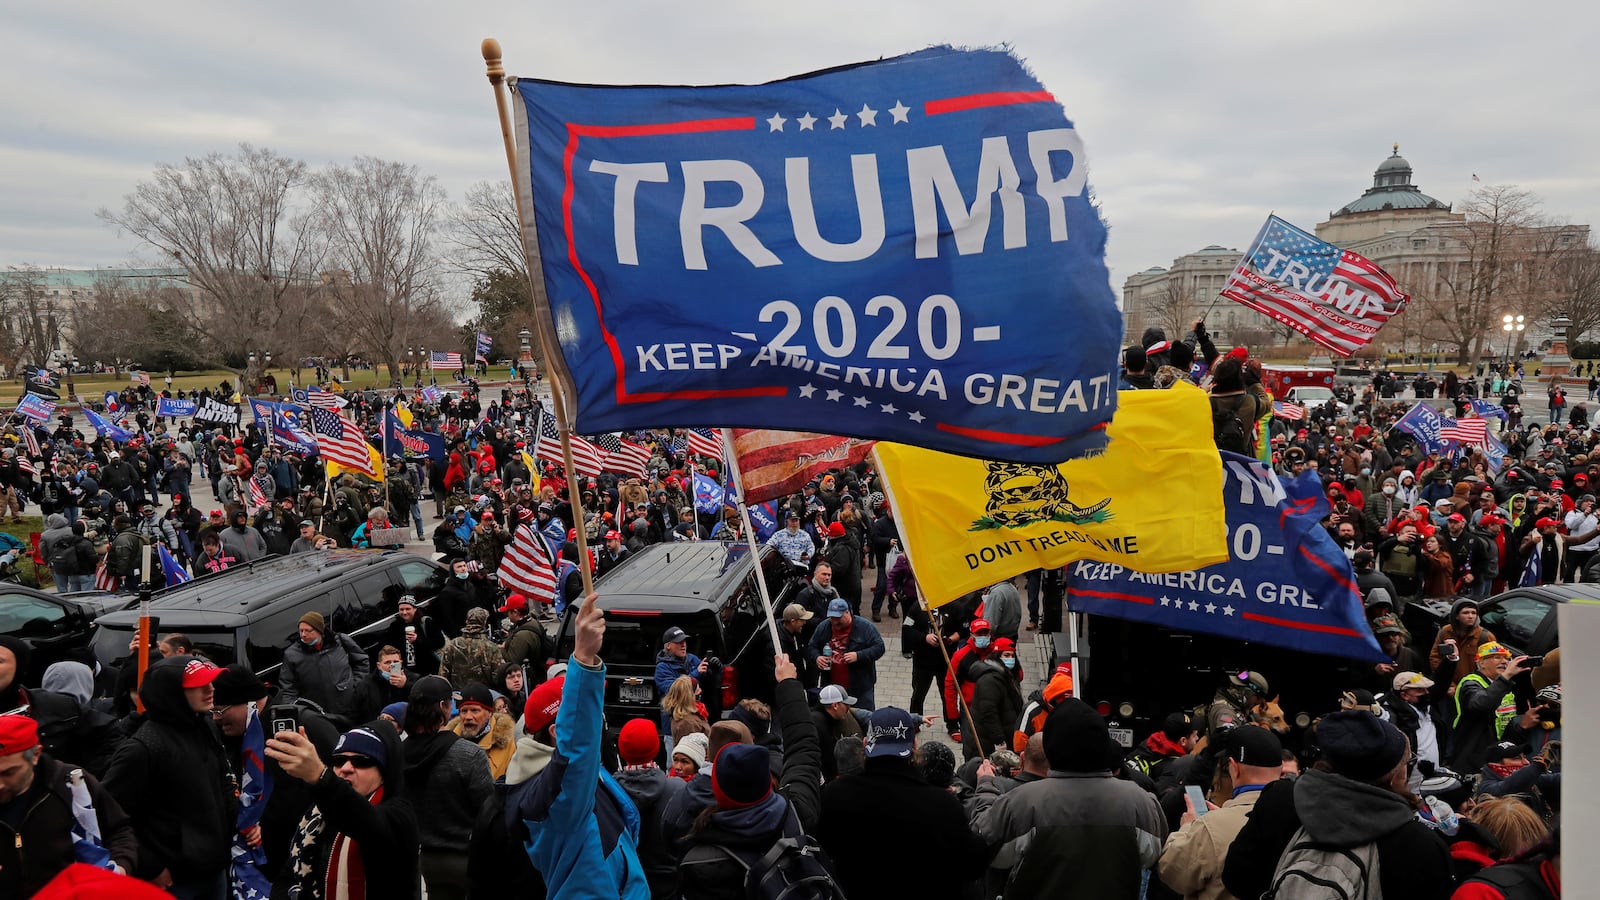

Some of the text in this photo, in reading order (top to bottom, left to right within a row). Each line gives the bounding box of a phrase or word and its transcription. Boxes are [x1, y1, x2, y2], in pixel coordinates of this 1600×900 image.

[589, 127, 1087, 271] TRUMP
[1262, 248, 1385, 319] TRUMP
[1314, 306, 1346, 323] GREAT
[636, 342, 1111, 414] KEEP AMERICA GREAT!
[166, 400, 195, 410] TRUMP
[194, 407, 238, 424] ANTIFA
[205, 397, 236, 414] FUCK
[965, 540, 1023, 570] DONT
[1026, 530, 1086, 552] TREAD
[1106, 536, 1139, 554] ME
[1074, 559, 1125, 580] KEEP
[1128, 567, 1247, 599] AMERICA
